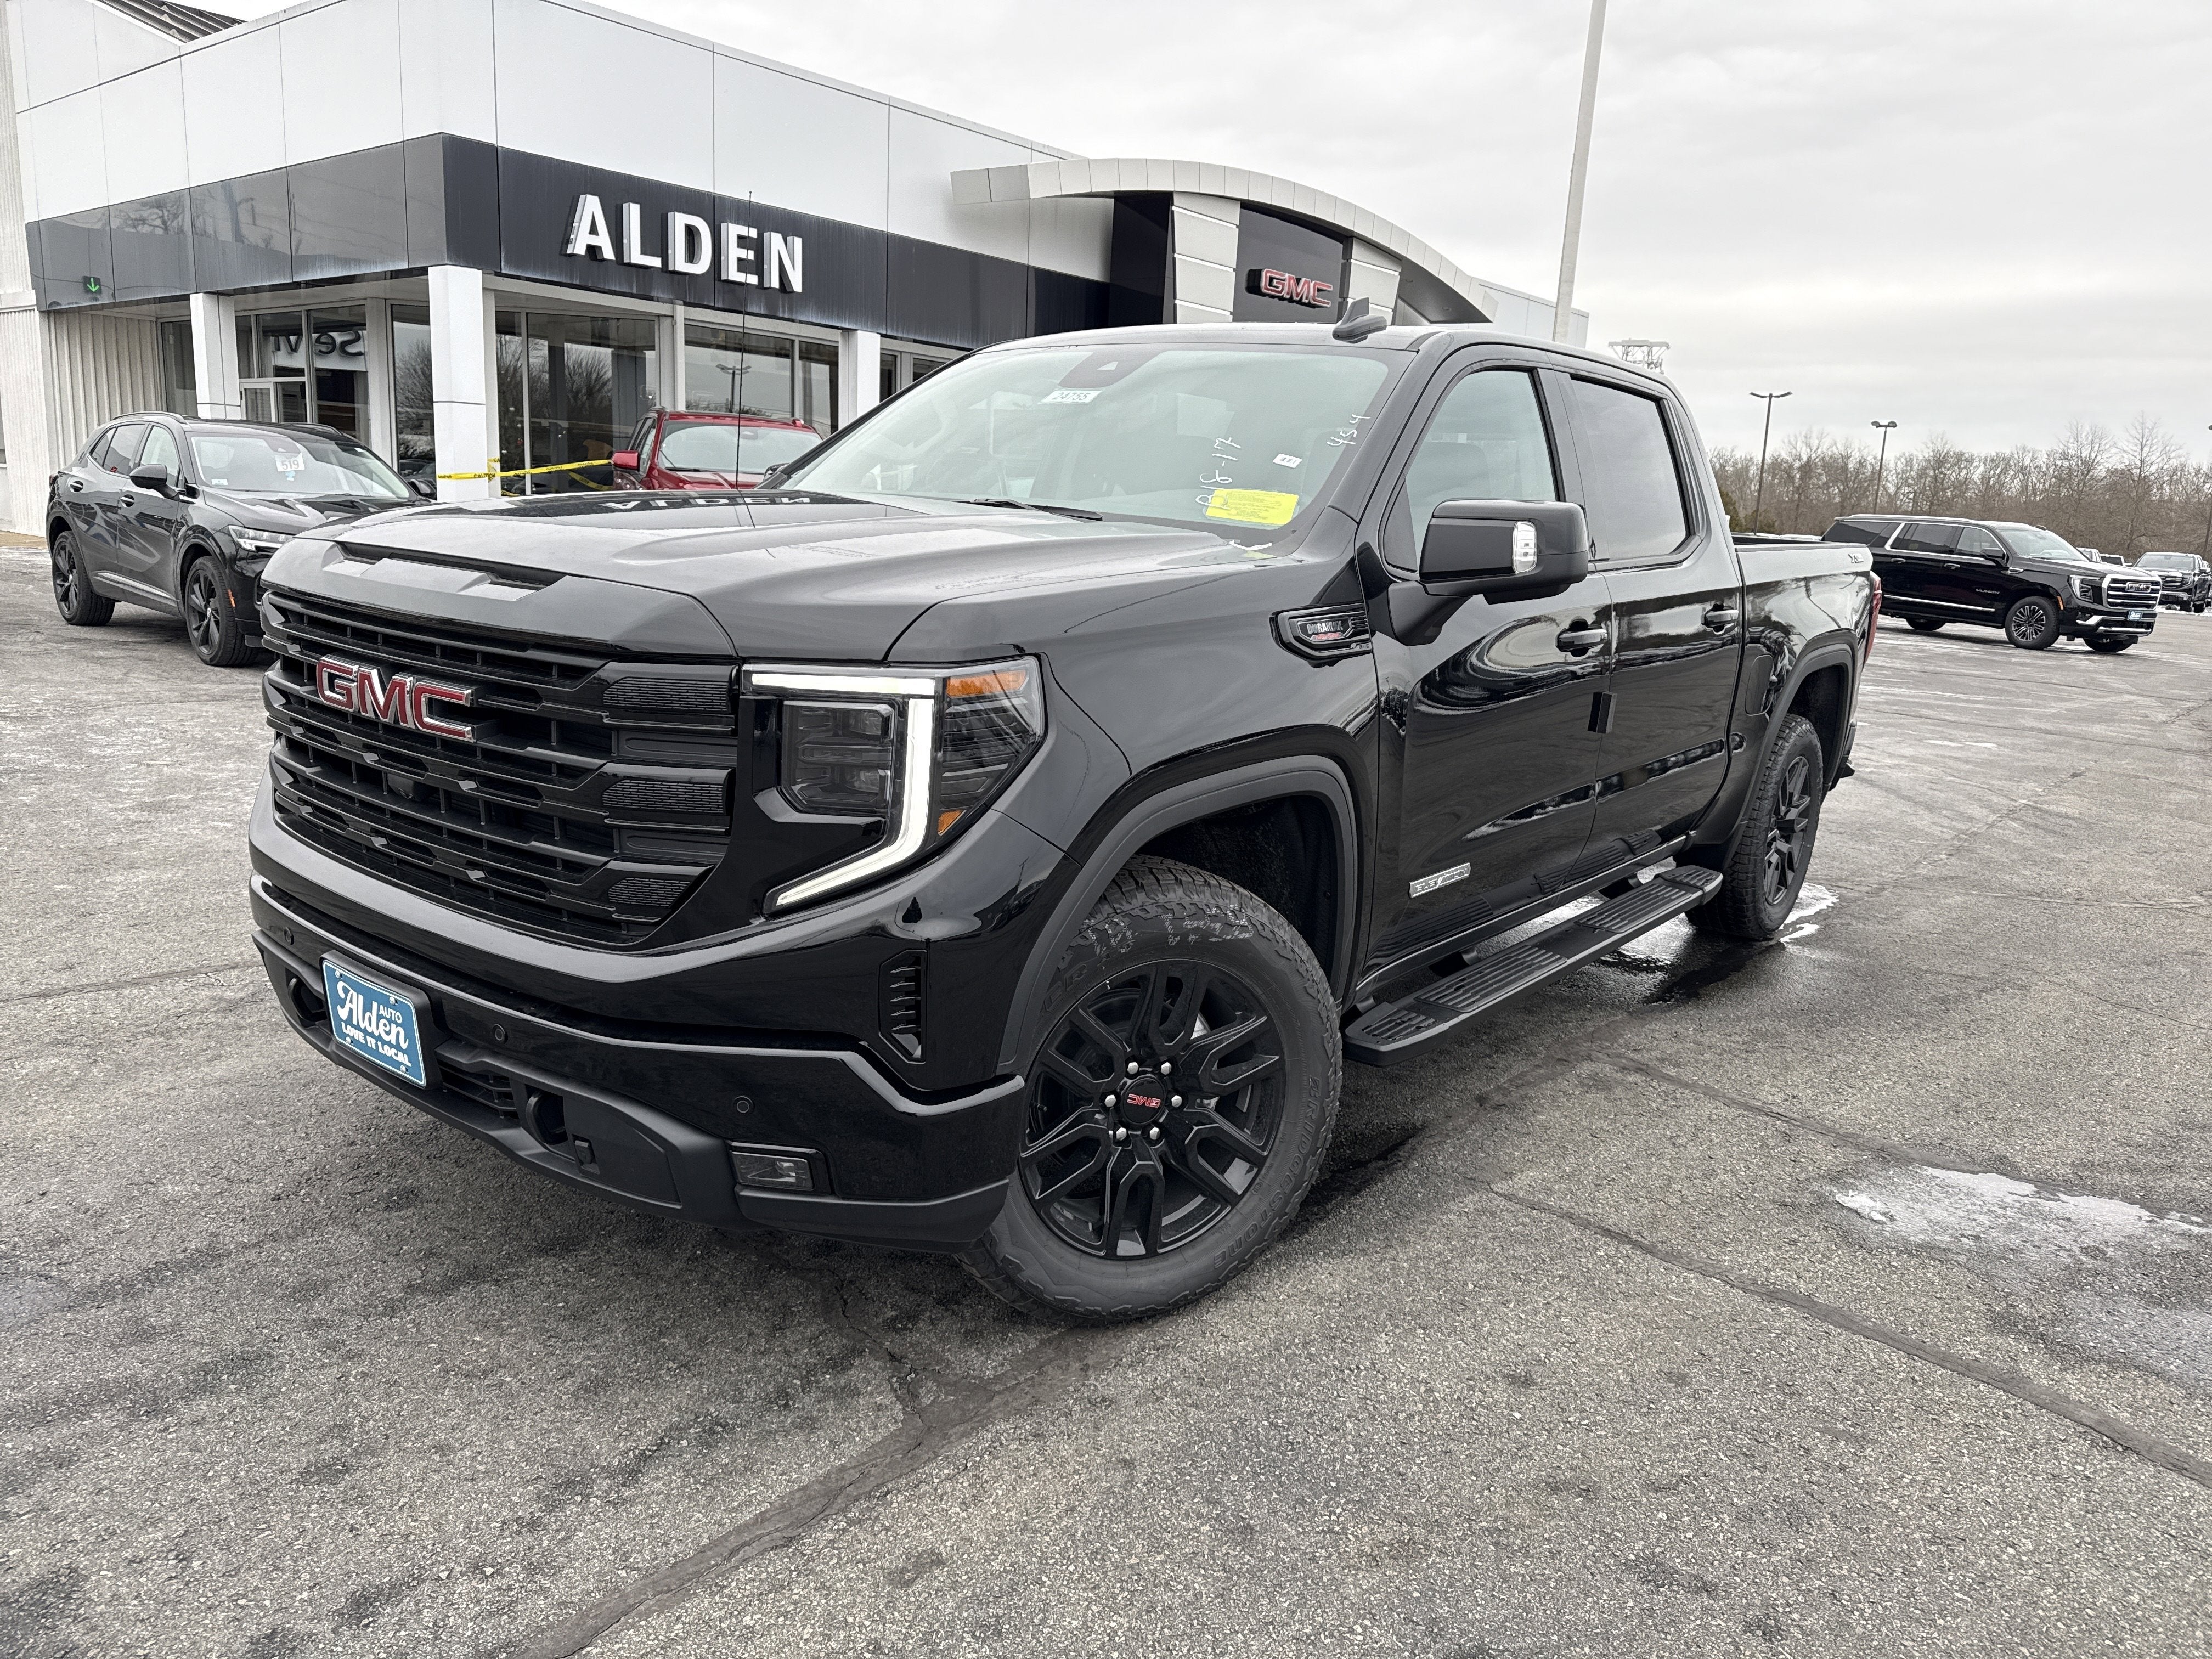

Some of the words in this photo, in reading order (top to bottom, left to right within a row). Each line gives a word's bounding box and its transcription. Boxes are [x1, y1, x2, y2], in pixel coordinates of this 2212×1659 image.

[567, 194, 803, 294] ALDEN
[1262, 268, 1333, 308] GMC
[281, 459, 300, 470] 519
[1306, 620, 1344, 634] DURAMAX
[316, 656, 475, 743] GMC
[337, 981, 409, 1049] Alden
[379, 1005, 402, 1024] AUTO
[341, 1021, 366, 1045] LOVE
[366, 1035, 376, 1051] IT
[377, 1040, 412, 1068] LOCAL
[1127, 1093, 1161, 1108] GMC
[1214, 1075, 1321, 1269] BRIDGESTONE
